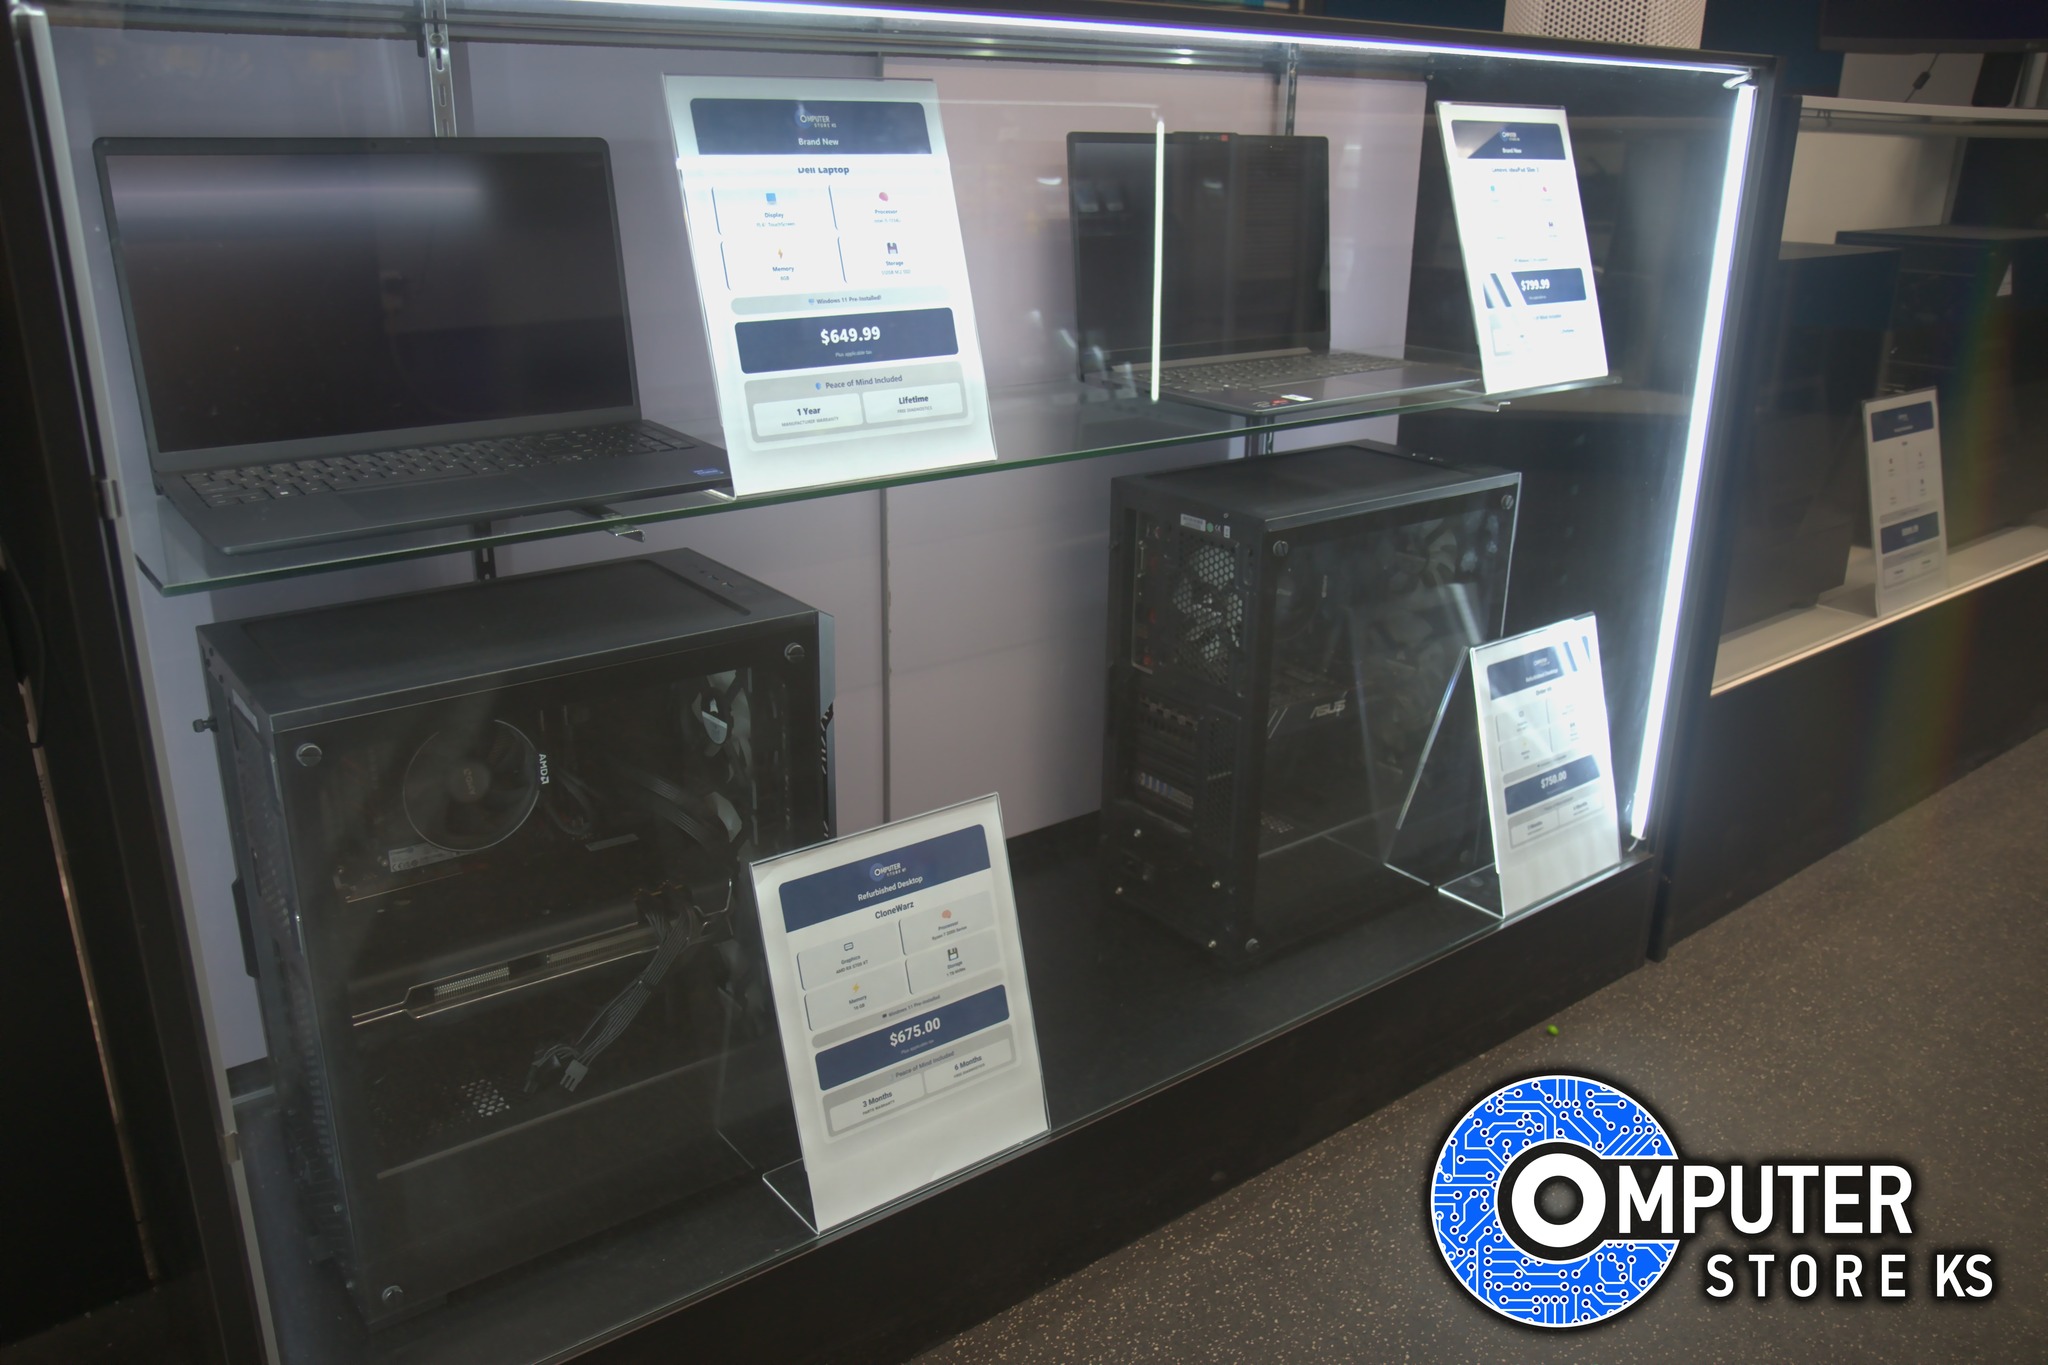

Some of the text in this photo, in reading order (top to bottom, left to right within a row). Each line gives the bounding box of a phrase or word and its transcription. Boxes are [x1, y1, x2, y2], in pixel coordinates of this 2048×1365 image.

[818, 167, 849, 175] Laptop
[1520, 278, 1550, 292] $799.99
[820, 326, 880, 346] $649.99
[856, 377, 873, 386] Mind
[875, 375, 902, 384] Included
[899, 395, 928, 404] Lifetime
[797, 407, 821, 416] 1 Year
[538, 753, 549, 776] AMD
[857, 876, 923, 901] Refurbished Desktop
[875, 902, 914, 919] CloneWarz
[841, 955, 860, 965] Graphics
[947, 961, 962, 969] Storage
[849, 995, 867, 1004] Memory
[890, 1017, 940, 1047] $675.00
[896, 1068, 912, 1077] Peace
[919, 1060, 932, 1068] Mind
[933, 1051, 955, 1063] Included
[960, 1056, 982, 1068] Months
[868, 1092, 892, 1105] Months
